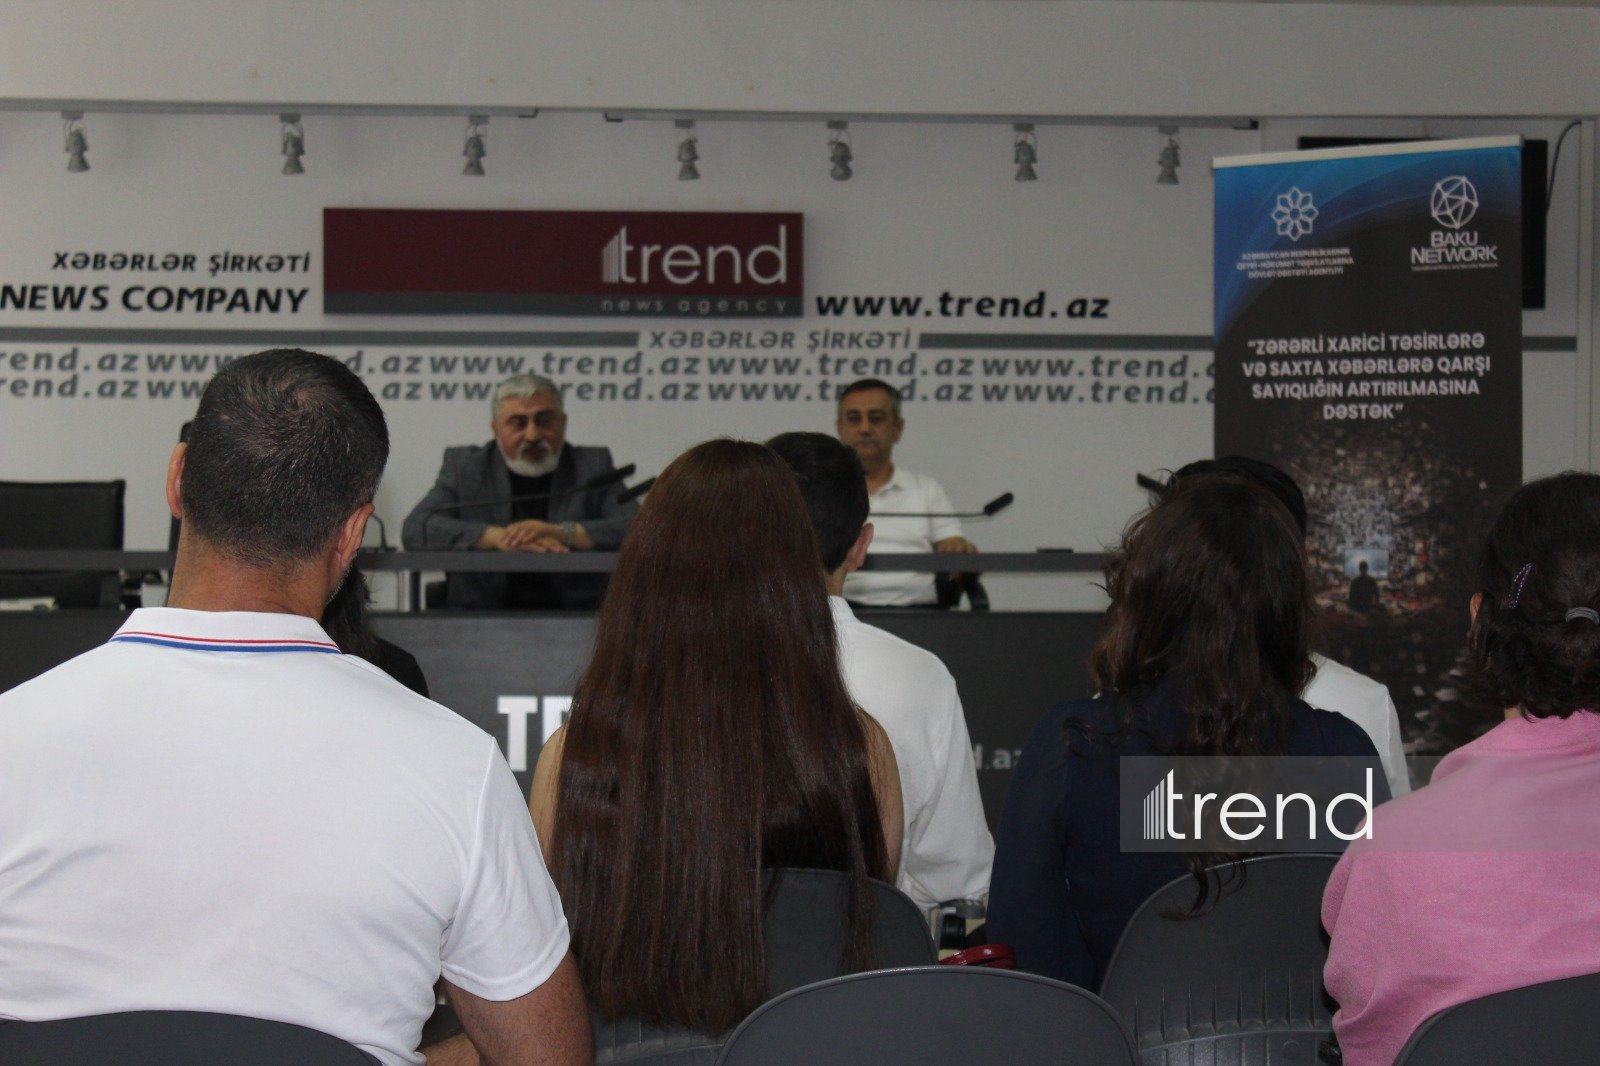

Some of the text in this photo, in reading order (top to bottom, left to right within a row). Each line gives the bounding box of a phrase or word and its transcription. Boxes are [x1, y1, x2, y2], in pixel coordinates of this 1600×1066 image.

[1430, 230, 1479, 248] BAKU
[52, 250, 311, 277] XƏBƏRLƏR ŞİRKƏTİ
[617, 224, 788, 284] trend
[1411, 245, 1498, 265] NETWORK
[0, 284, 310, 313] NEWS COMPANY
[601, 299, 786, 315] news agency
[815, 291, 1111, 319] www.trend.az
[650, 329, 912, 353] XƏBƏRLƏR ŞİRKƏTİ
[1327, 332, 1386, 352] XARİCİ
[1389, 331, 1486, 351] TƏSİRLƏRƏ
[708, 352, 975, 376] www.trend.az
[1242, 355, 1491, 377] VƏ SAXTA XƏBƏRLƏRƏ QARŞI
[1347, 378, 1481, 398] ARTIRILMASINA
